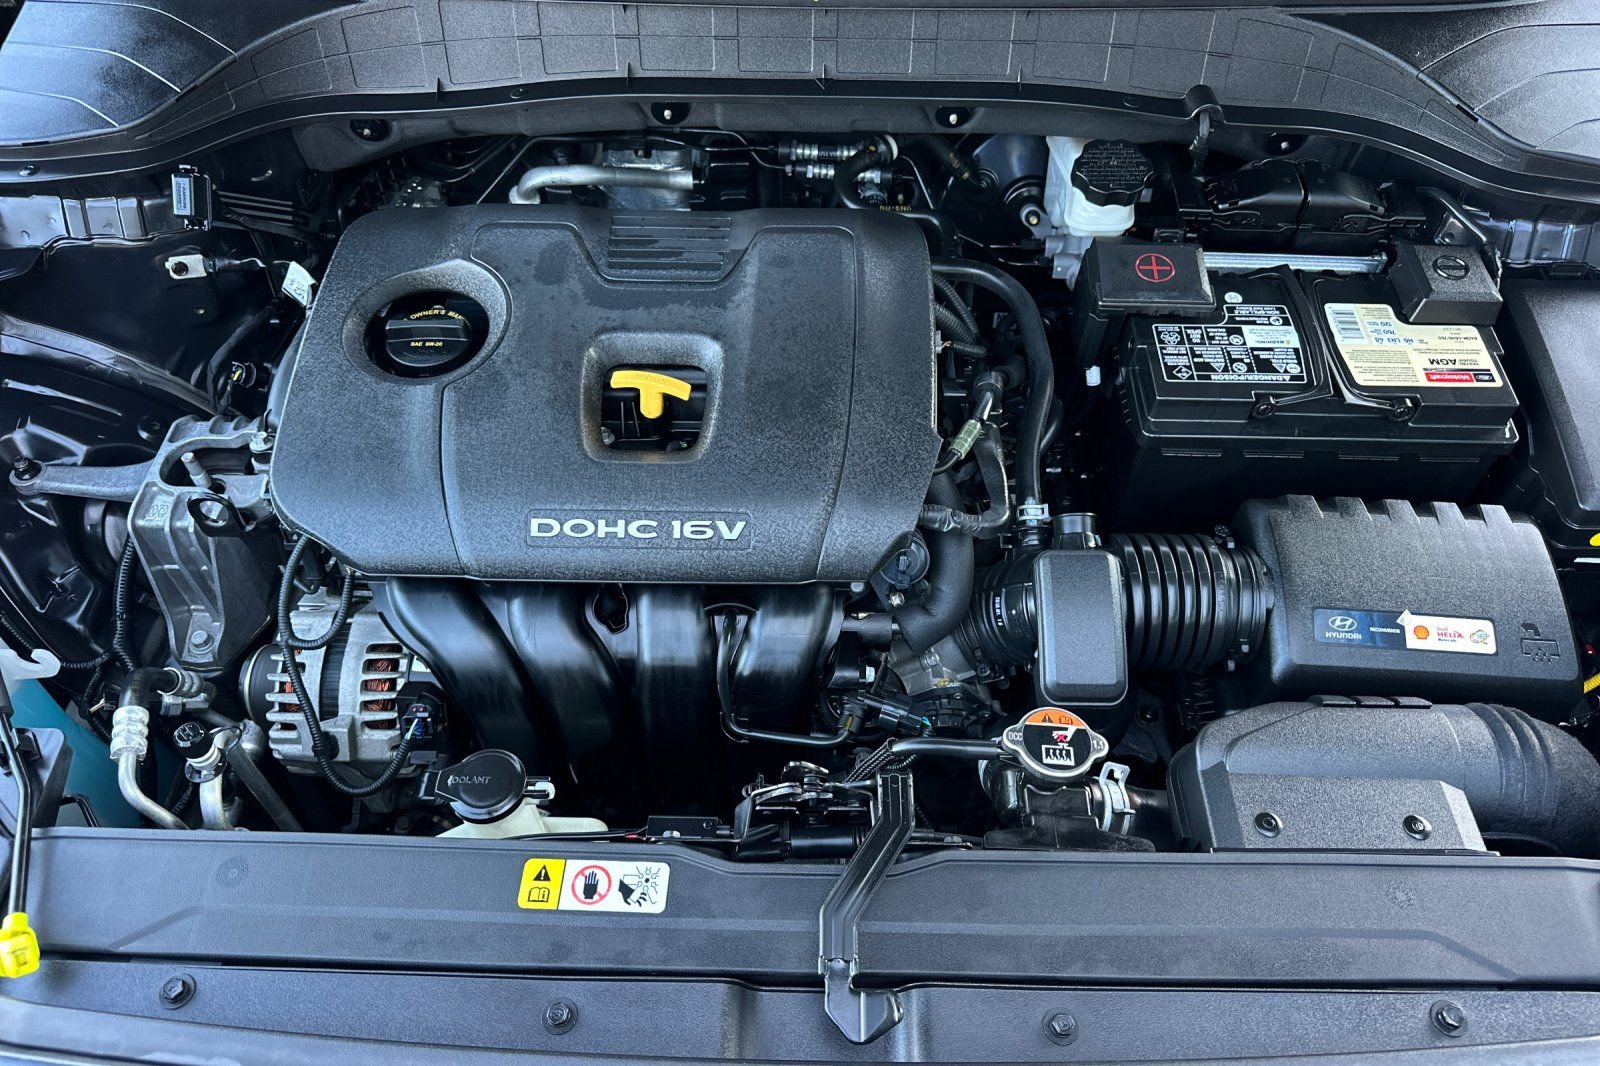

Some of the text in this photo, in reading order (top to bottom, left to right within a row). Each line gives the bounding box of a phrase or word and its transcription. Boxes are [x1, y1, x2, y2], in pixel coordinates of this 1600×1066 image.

[410, 309, 446, 320] OWNER'S
[529, 518, 747, 541] DOHC 16V
[1325, 631, 1362, 640] HYUNDAI
[1437, 631, 1465, 639] HELIX
[1008, 731, 1023, 741] DCC
[1092, 739, 1104, 749] 1.1
